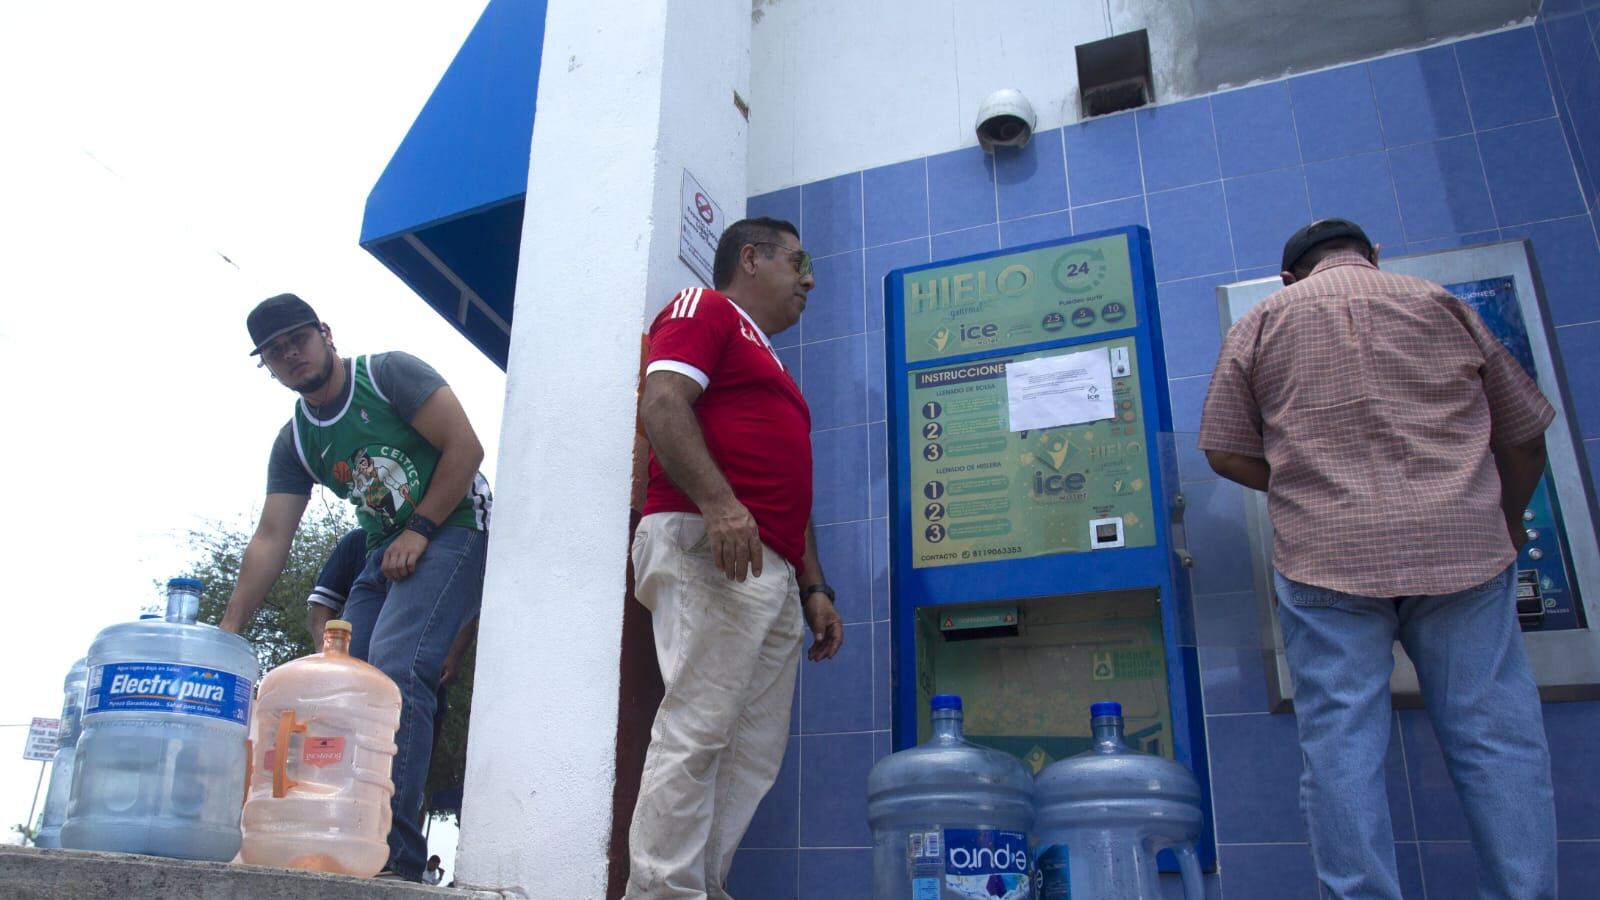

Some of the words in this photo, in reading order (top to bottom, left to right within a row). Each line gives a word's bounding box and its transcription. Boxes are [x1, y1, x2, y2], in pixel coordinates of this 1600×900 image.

[1066, 261, 1090, 277] 24
[911, 264, 1034, 313] HIELO
[1079, 310, 1086, 318] 5
[1108, 304, 1120, 313] 10
[960, 323, 998, 342] ice
[921, 363, 1006, 384] INSTRUCCIONE
[927, 402, 935, 418] 1
[926, 421, 938, 438] 2
[927, 444, 939, 461] 3
[380, 446, 420, 487] CELTICS
[929, 482, 937, 498] 1
[1034, 470, 1087, 495] ice
[928, 503, 941, 520] 2
[929, 525, 941, 542] 3
[920, 552, 958, 561] CONTACTO
